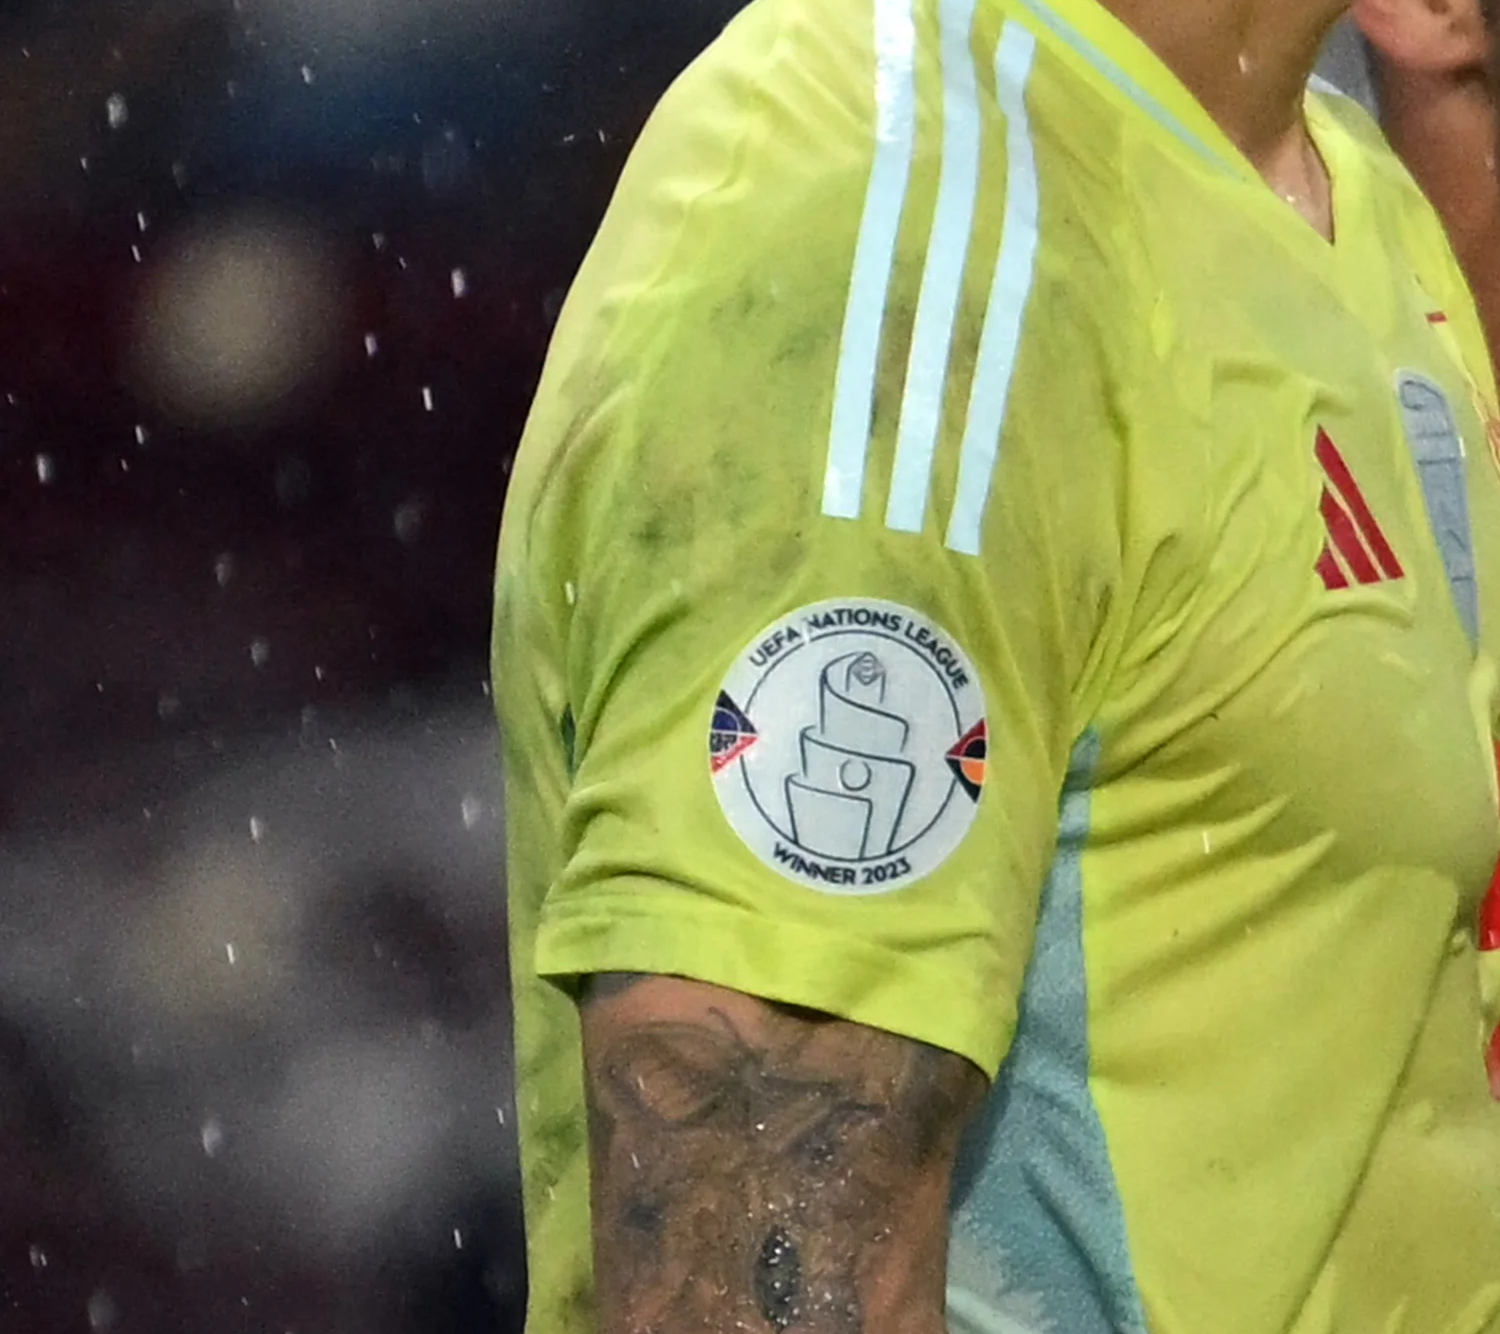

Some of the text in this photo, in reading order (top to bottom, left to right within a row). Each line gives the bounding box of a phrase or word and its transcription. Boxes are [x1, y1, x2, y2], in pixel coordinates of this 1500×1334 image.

[749, 607, 970, 689] UEFA NATIONS LEAGUE
[772, 842, 912, 885] WINNER 2023
